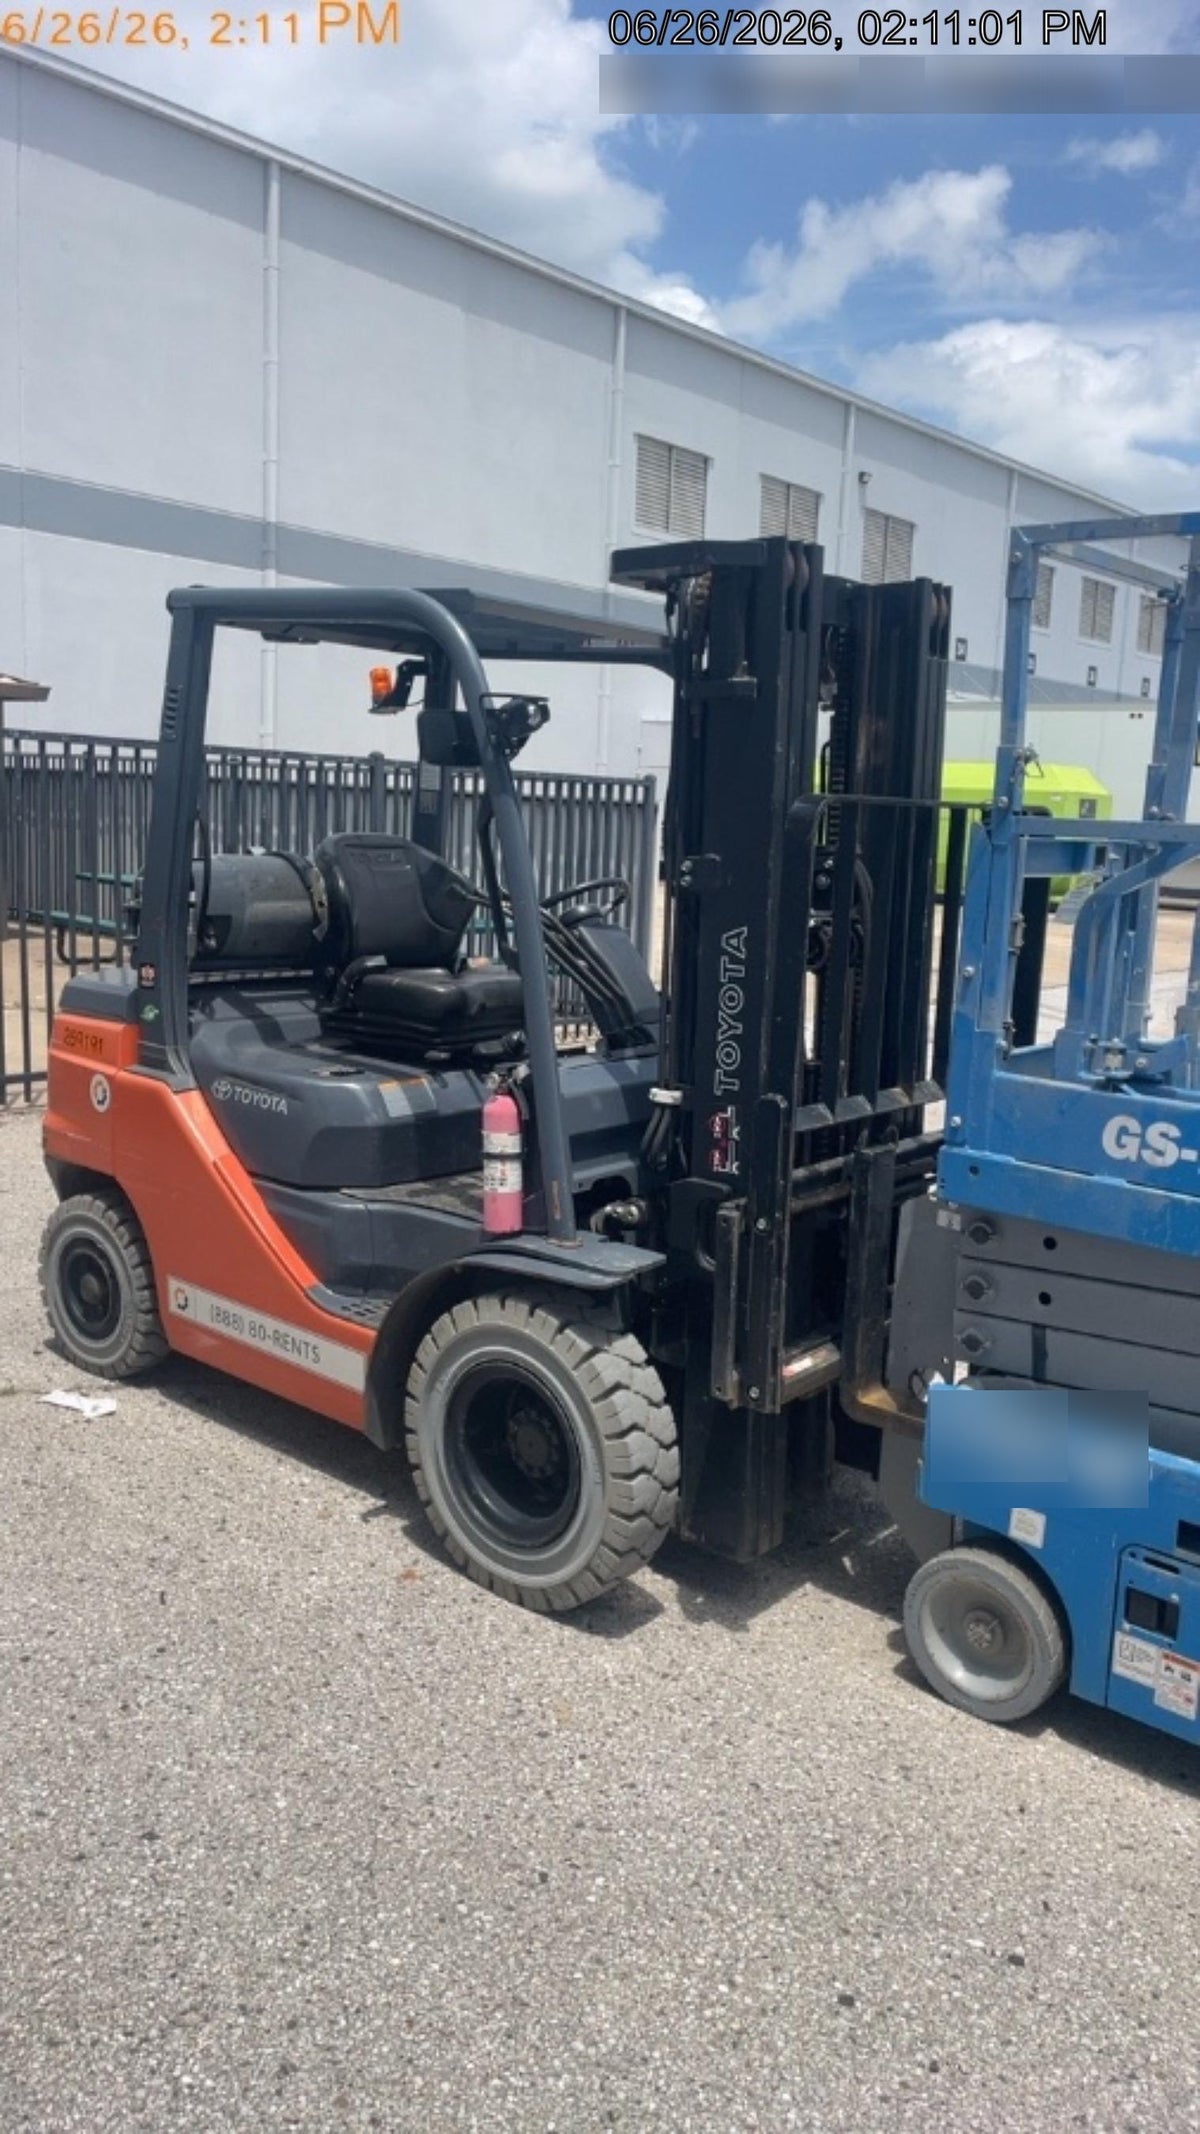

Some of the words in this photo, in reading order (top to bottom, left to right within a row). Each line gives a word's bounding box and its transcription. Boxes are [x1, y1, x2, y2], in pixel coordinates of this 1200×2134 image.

[713, 926, 749, 1097] TOYOTA
[233, 1085, 289, 1116] TOYOTA
[209, 1303, 245, 1335] (888)
[248, 1320, 322, 1365] 80-RENTS
